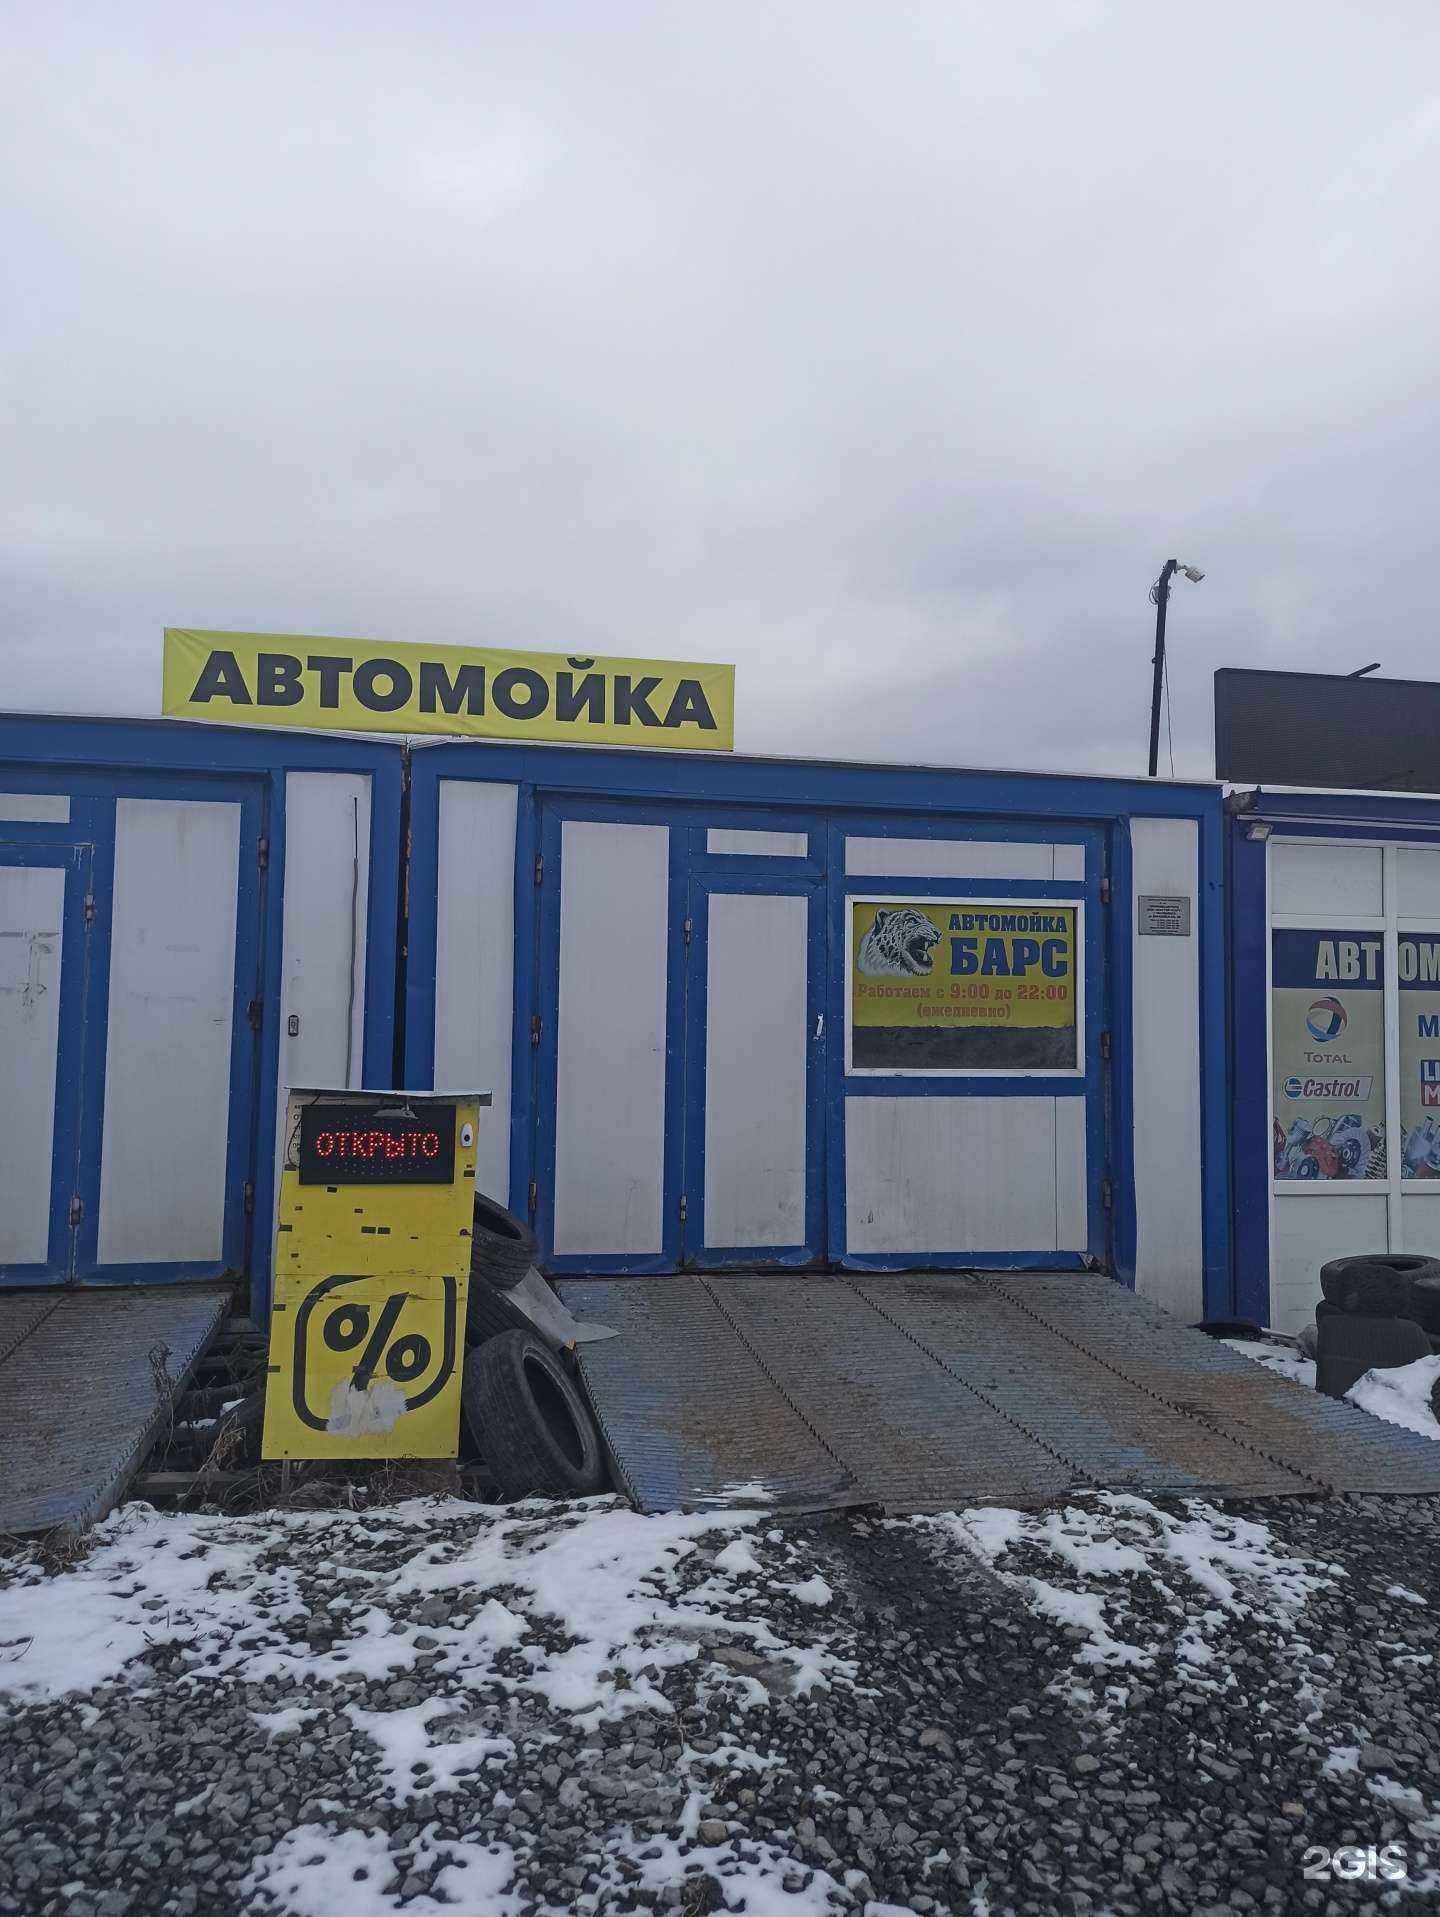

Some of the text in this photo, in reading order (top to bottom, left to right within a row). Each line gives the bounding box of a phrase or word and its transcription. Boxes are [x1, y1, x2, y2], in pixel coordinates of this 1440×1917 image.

[189, 650, 718, 730] АВТОМОЙКА
[949, 912, 1068, 933] АВТОМОЙКА
[950, 937, 1068, 977] БАРС
[858, 983, 931, 999] Работаем
[950, 983, 990, 999] 9:00
[995, 989, 1012, 1000] до
[1017, 984, 1068, 1000] 22:00
[1303, 1080, 1360, 1098] Castrol
[315, 1132, 440, 1157] ОТКРЫТО
